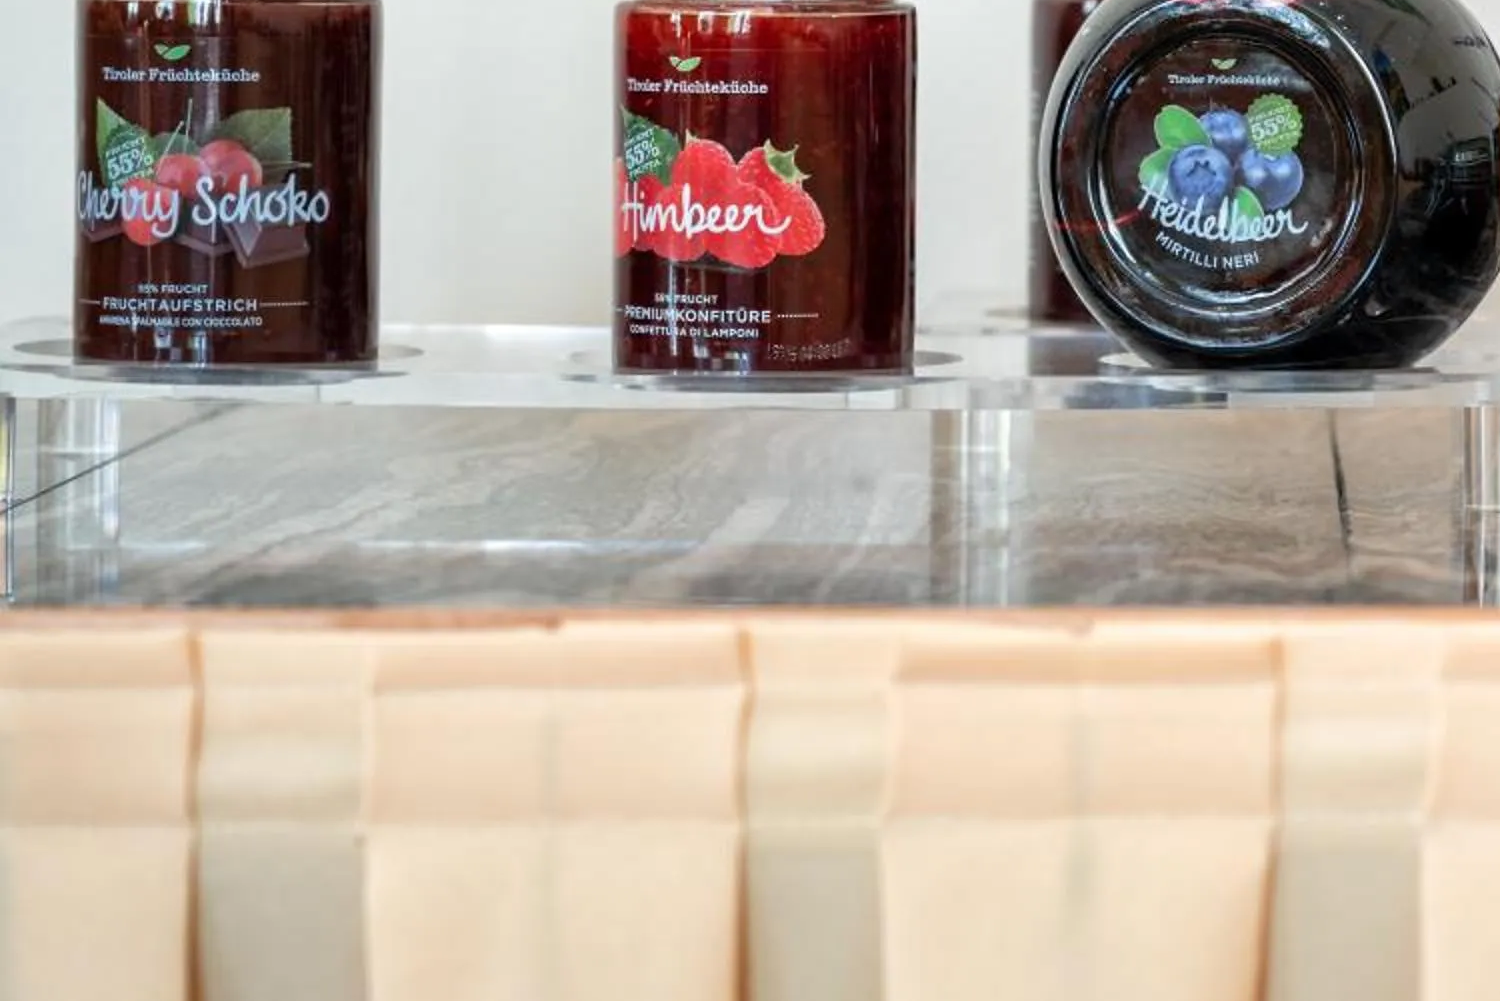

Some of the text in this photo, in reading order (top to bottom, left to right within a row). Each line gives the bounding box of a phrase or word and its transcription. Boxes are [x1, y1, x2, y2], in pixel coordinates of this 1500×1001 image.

[102, 67, 260, 82] Tiroler Früchteküche
[627, 79, 768, 94] Tiroler Früchteküche
[1251, 114, 1298, 141] 55%
[77, 170, 179, 239] Cherry
[191, 173, 330, 227] Schoko
[621, 181, 792, 243] Himbeer
[1138, 172, 1308, 242] Heidelbeer
[1155, 230, 1260, 269] MIRTILLI NERI
[161, 284, 208, 294] FRUCHT
[103, 297, 258, 312] FRUCHTAUFSTRICH
[674, 294, 719, 304] FRUCHT
[624, 304, 771, 323] PREMIUMKONFITÜRE
[203, 317, 262, 327] CIOCCOLATO
[703, 327, 760, 339] LAMPONI
